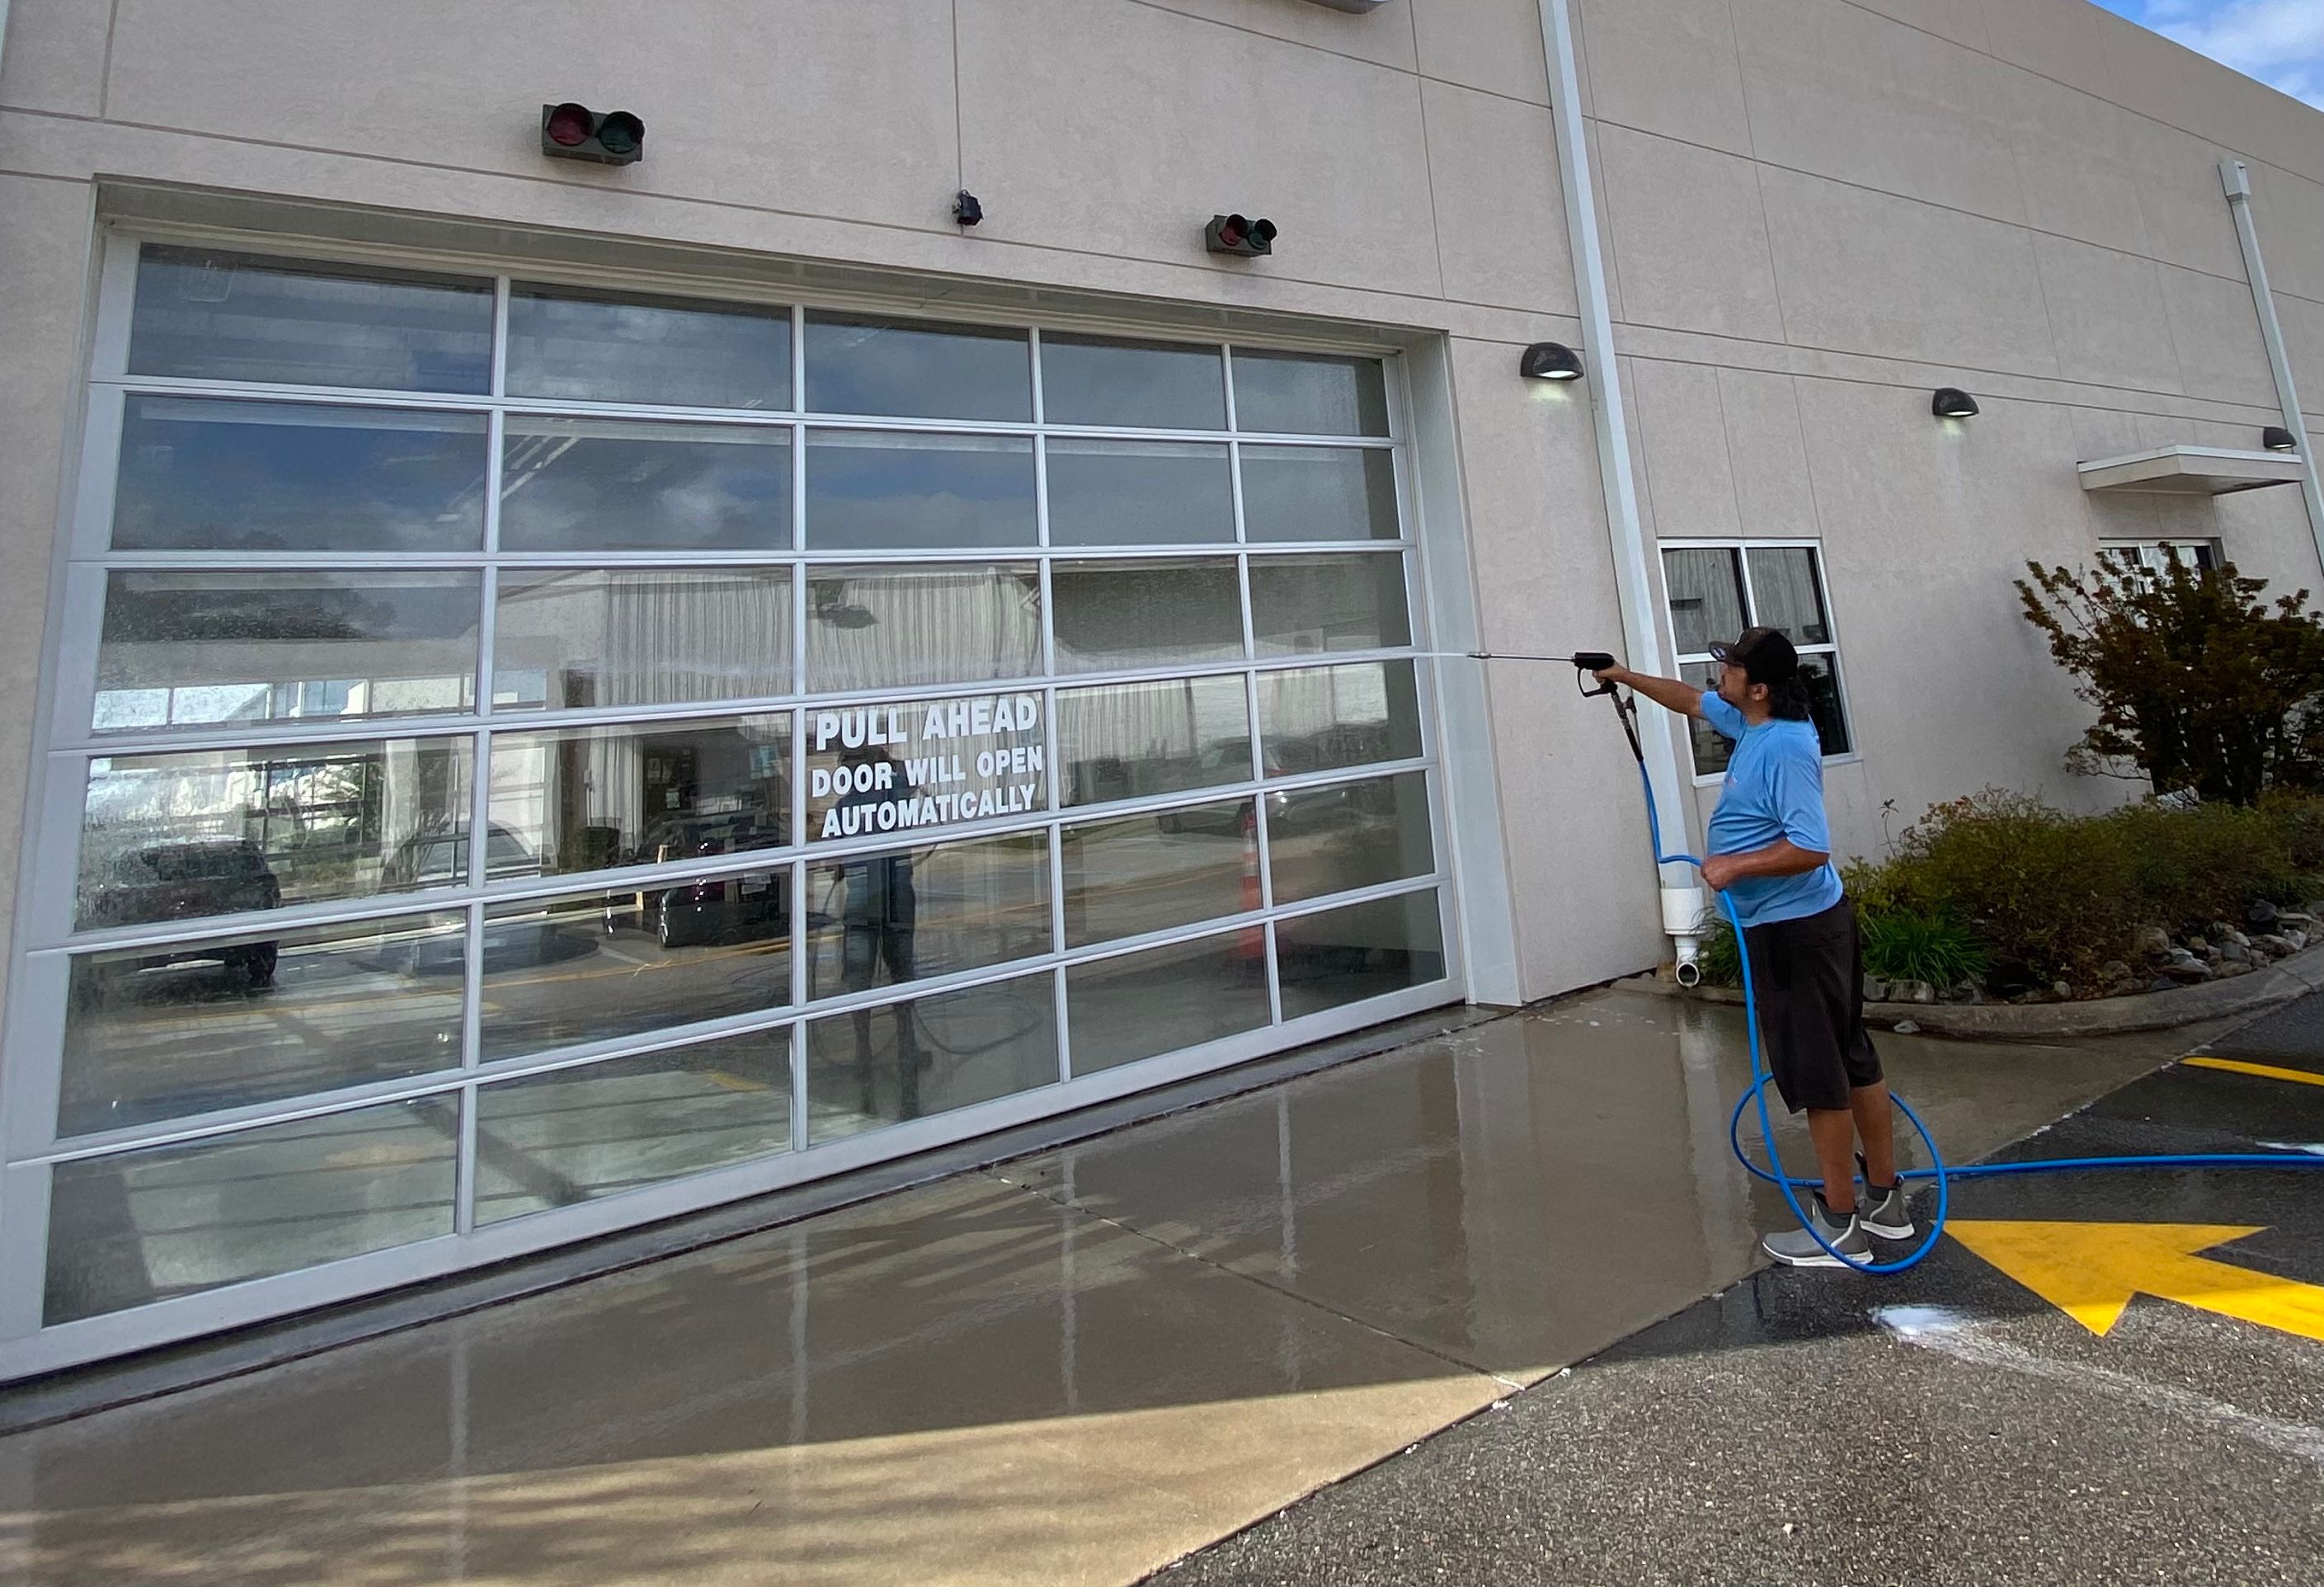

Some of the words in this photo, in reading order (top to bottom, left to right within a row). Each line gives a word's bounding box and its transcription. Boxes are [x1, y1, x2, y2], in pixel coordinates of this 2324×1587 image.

[816, 707, 907, 751] PULL
[922, 695, 1037, 740] AHEAD
[812, 762, 892, 798] DOOR
[905, 754, 966, 787] WILL
[976, 745, 1042, 778] OPEN
[821, 784, 1036, 838] AUTOMATICALLY
